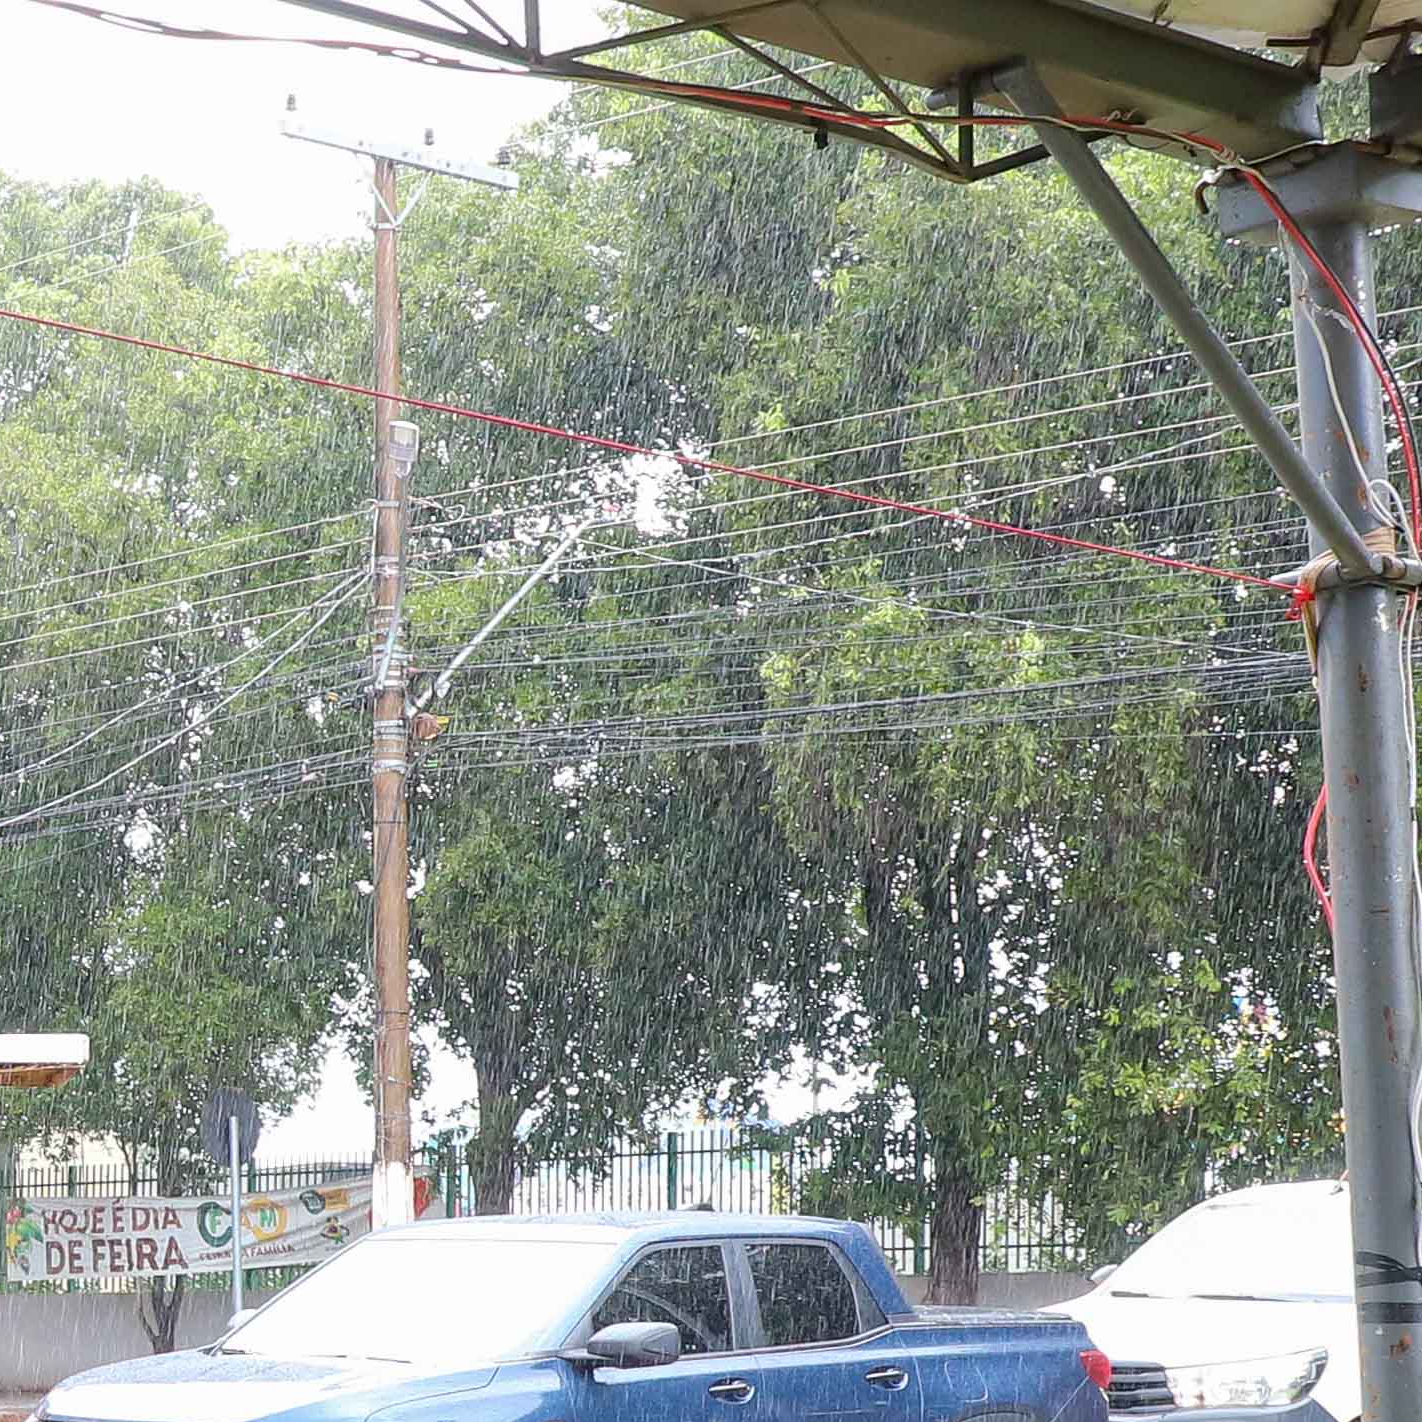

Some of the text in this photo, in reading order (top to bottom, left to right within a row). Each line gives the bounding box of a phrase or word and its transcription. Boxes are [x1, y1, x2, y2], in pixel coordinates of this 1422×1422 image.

[41, 1197, 182, 1235] HOJE É DIA
[45, 1235, 189, 1275] DE FEIRA
